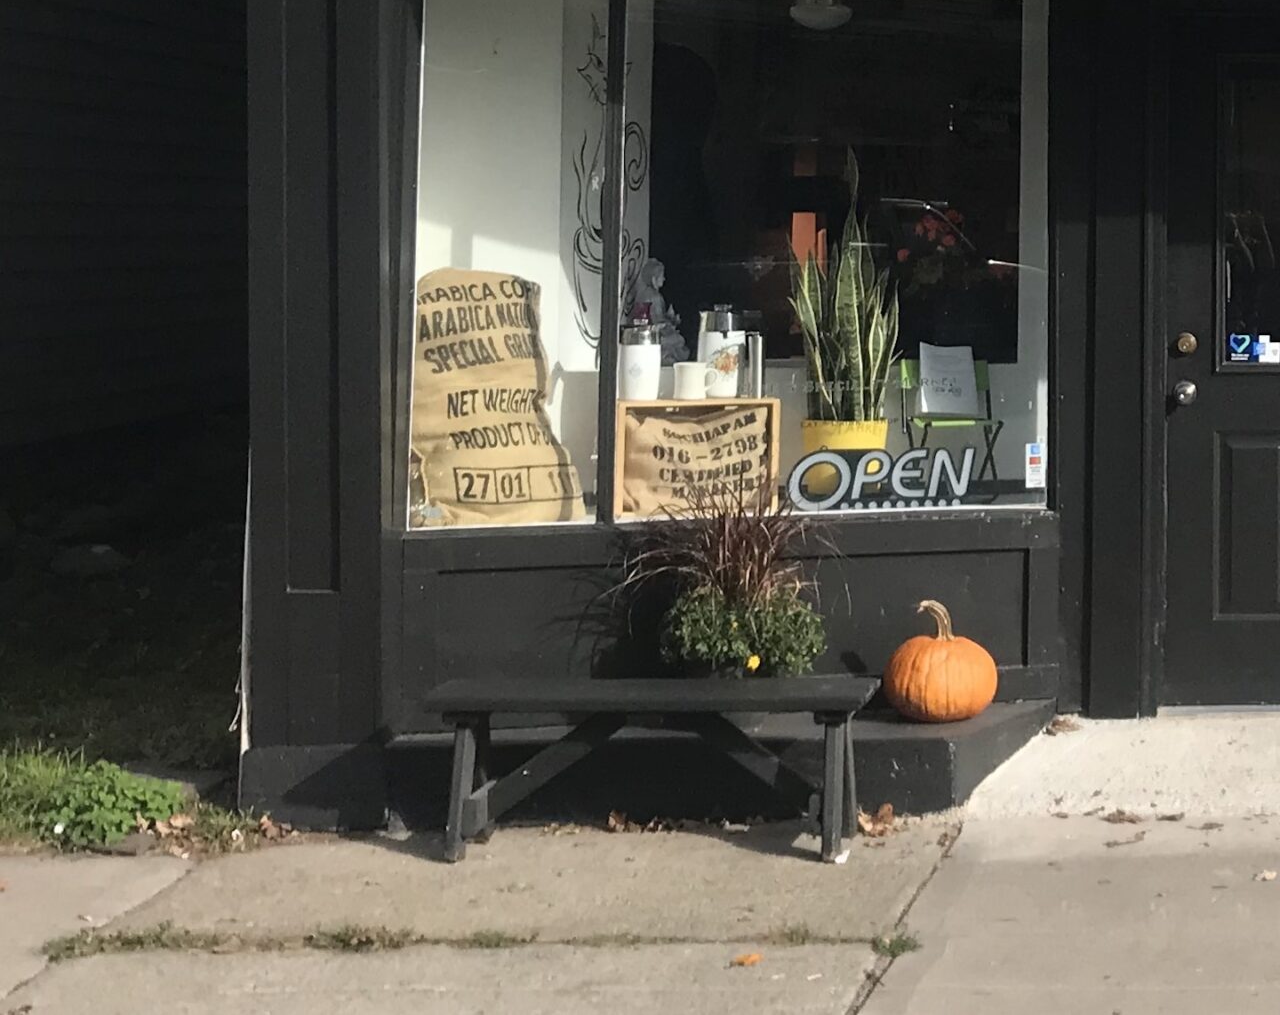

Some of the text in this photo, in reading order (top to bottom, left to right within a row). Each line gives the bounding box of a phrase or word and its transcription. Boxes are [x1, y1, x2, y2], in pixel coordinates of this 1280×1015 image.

[419, 304, 497, 343] ARABICA
[424, 335, 504, 374] SPECIAL
[446, 389, 479, 419] NET
[449, 422, 526, 450] PRODUCT
[460, 472, 491, 500] 27
[500, 472, 527, 499] 01
[788, 447, 976, 512] OPEN
